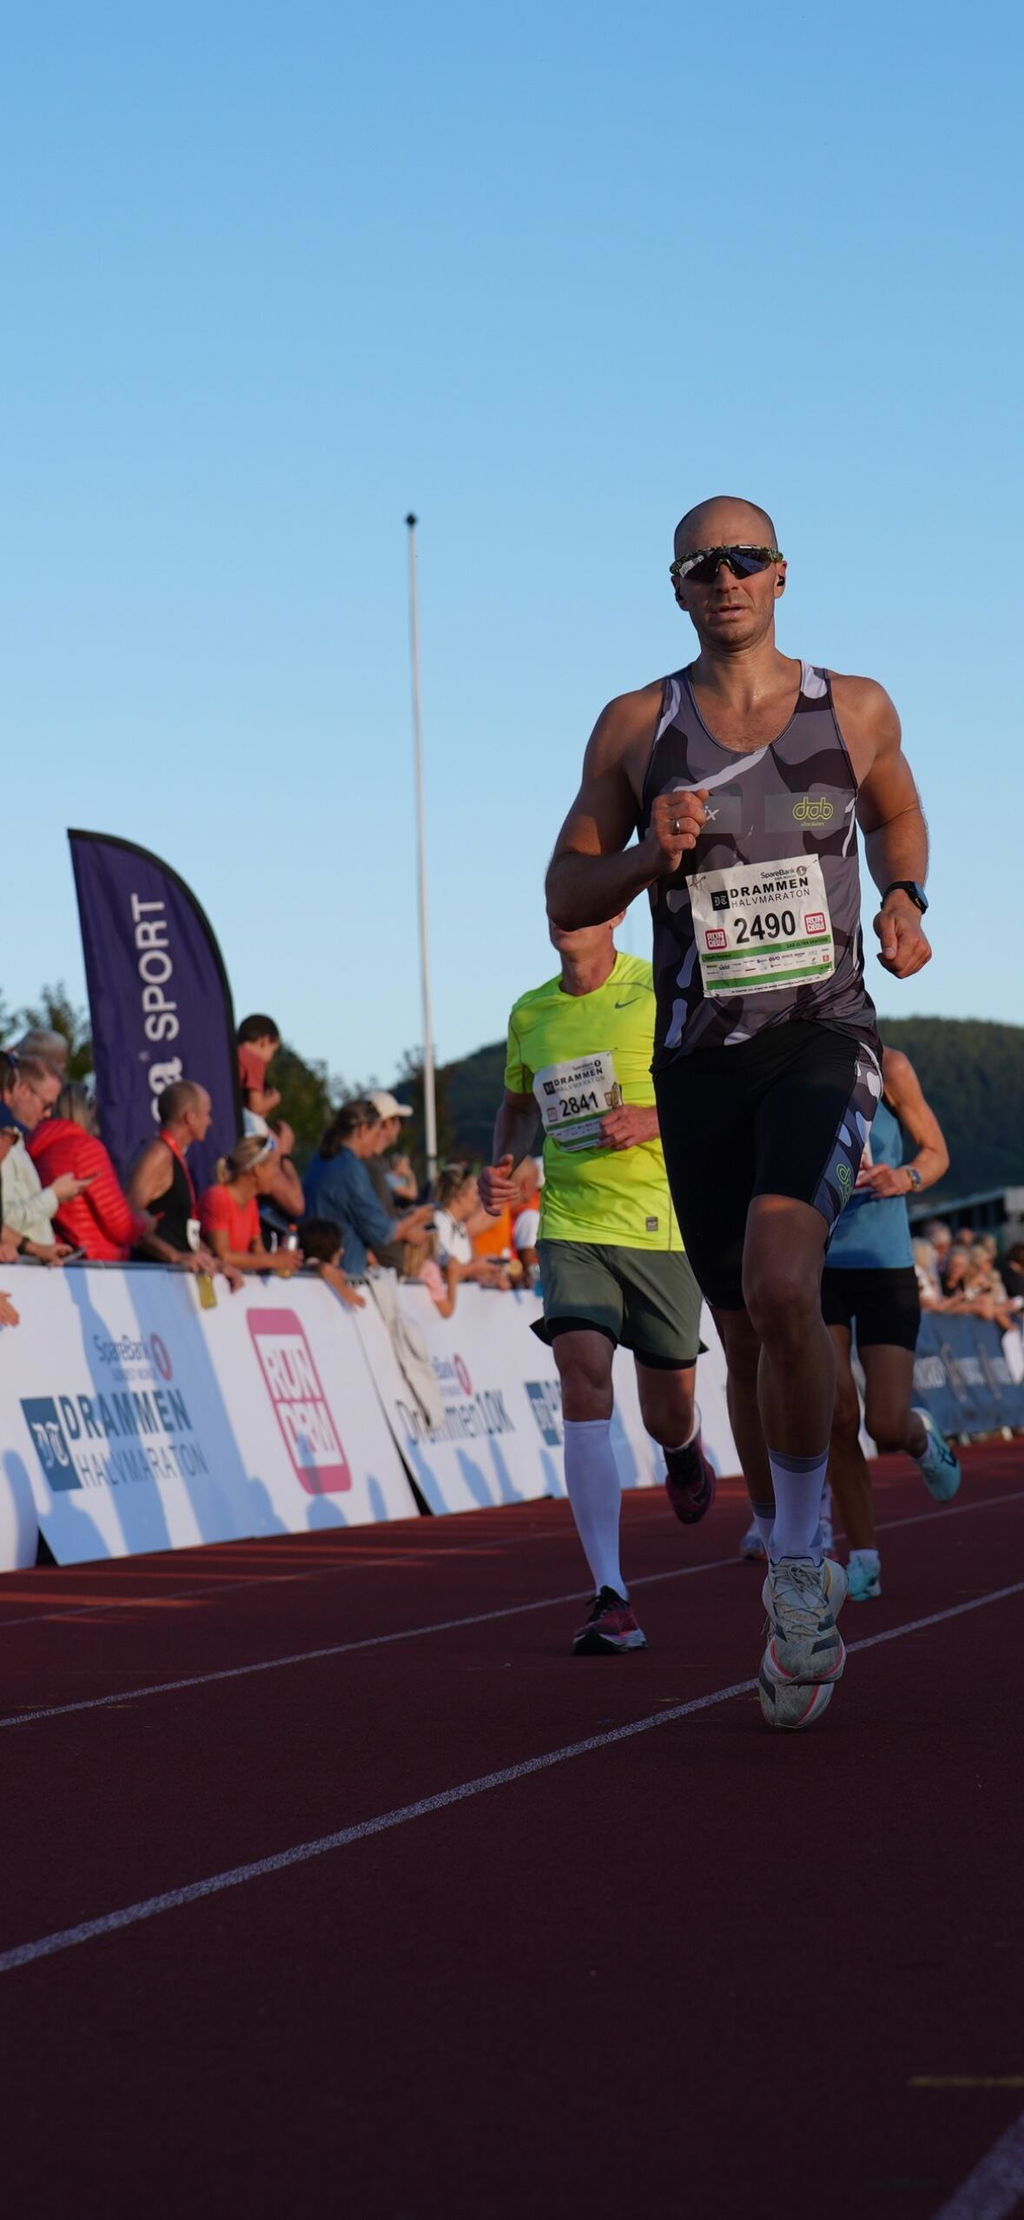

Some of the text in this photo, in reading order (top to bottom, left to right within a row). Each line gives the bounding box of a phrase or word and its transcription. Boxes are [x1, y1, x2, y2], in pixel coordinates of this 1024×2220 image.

[730, 877, 809, 898] DRAMMEN
[732, 888, 810, 908] HALVMARATON
[734, 910, 796, 944] 2490
[131, 893, 180, 1041] SPORT
[554, 1067, 603, 1087] DRAMMEN
[560, 1091, 599, 1117] 2841
[262, 1348, 321, 1399] RUN
[58, 1389, 192, 1440] DRAMMEN
[75, 1442, 209, 1490] HALVMARATON
